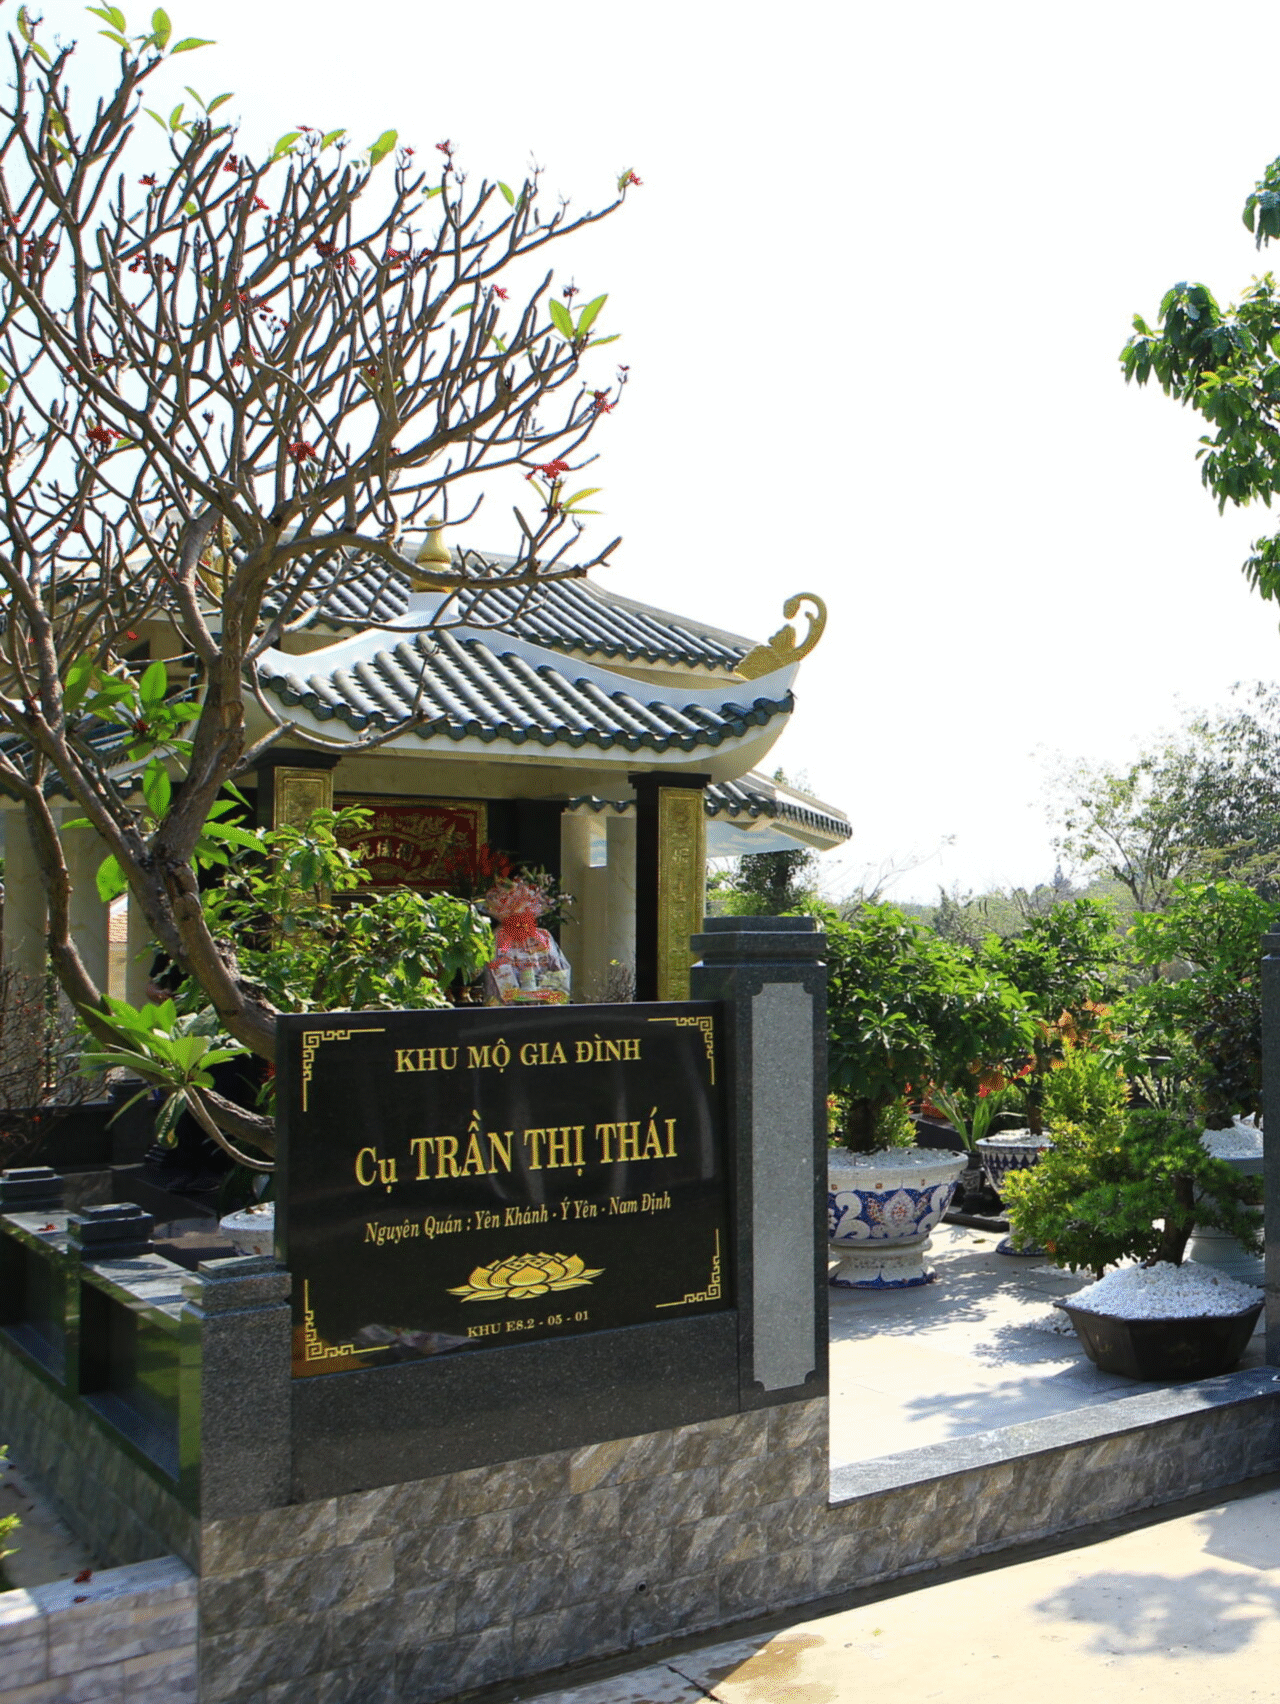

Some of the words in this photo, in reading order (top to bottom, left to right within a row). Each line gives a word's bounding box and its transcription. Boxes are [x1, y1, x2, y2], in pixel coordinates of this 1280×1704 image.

[395, 1047, 459, 1072] KHU
[467, 1037, 511, 1073] MỘ
[520, 1041, 568, 1066] GIA
[575, 1033, 642, 1063] ĐÌNH
[355, 1147, 398, 1193] Cụ
[410, 1109, 514, 1181] TRẦN
[523, 1125, 586, 1177] THỊ
[595, 1106, 678, 1164] THÁI
[364, 1218, 419, 1245] Nguyên
[424, 1214, 462, 1240] Quán
[474, 1210, 500, 1231] Yên
[504, 1203, 548, 1228] Khánh
[559, 1196, 571, 1221] Ý
[573, 1200, 598, 1219] Yên
[609, 1196, 638, 1216] Nam
[641, 1191, 671, 1215] Định
[467, 1322, 500, 1338] KHU
[506, 1318, 534, 1334] E8.2
[547, 1314, 563, 1326] 05
[575, 1310, 589, 1322] 01
